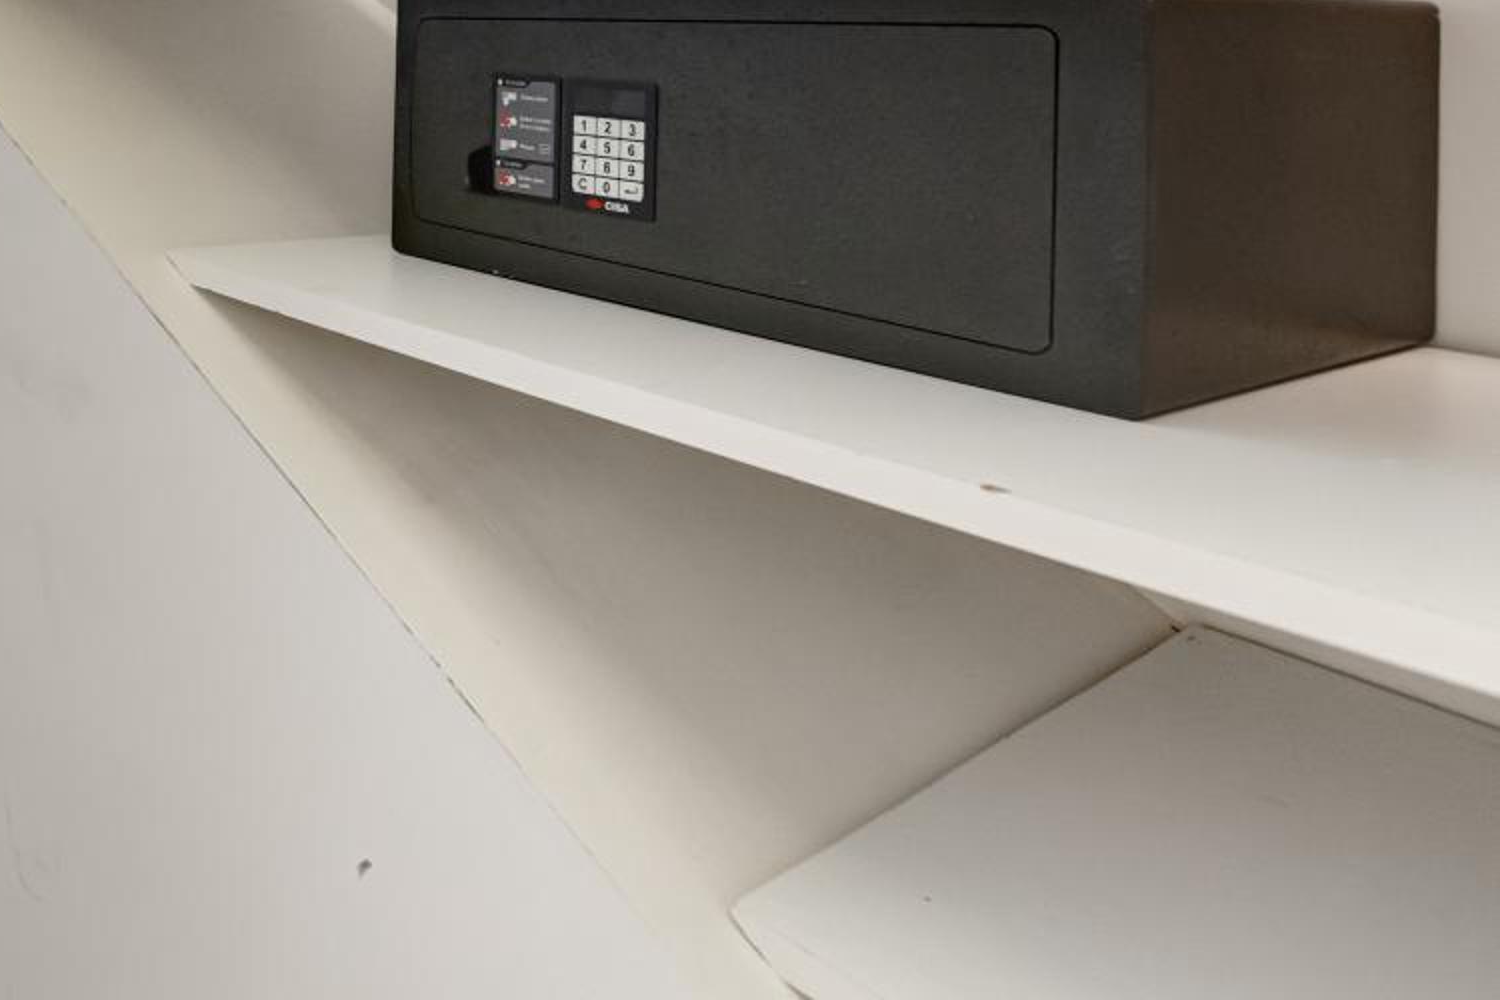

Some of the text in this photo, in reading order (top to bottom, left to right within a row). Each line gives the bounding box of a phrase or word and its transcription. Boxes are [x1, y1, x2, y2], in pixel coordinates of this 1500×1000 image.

[581, 119, 637, 137] 1 2 3
[580, 138, 636, 157] 4 5 6
[580, 158, 587, 170] 7
[628, 164, 635, 177] 9
[579, 177, 611, 194] C 0
